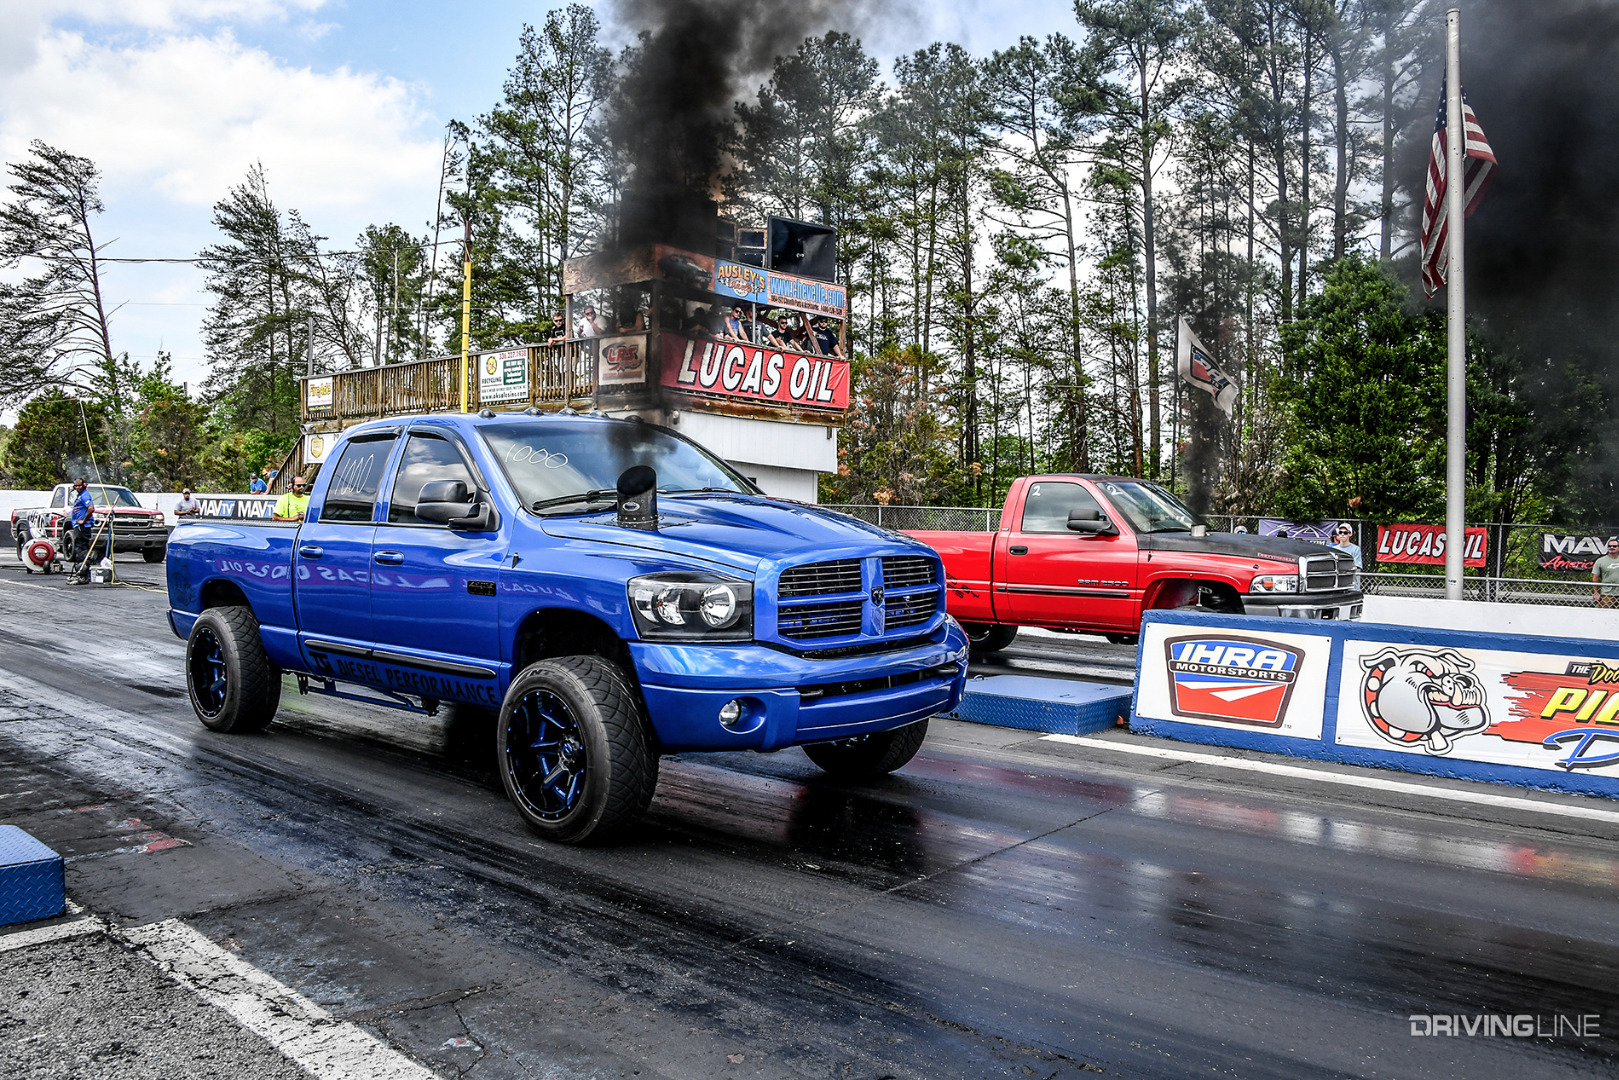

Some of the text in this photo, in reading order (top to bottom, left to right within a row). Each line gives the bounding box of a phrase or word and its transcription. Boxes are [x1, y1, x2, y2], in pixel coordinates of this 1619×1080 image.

[717, 264, 766, 289] AUSLEY'S
[770, 276, 844, 308] www.chevelle.com
[678, 339, 835, 403] LUCAS OIL
[505, 443, 569, 470] 1000
[1032, 484, 1041, 498] 2
[1105, 483, 1124, 498] 2
[198, 499, 277, 518] MAVTV MAVT
[1378, 529, 1485, 560] LUCAS IL
[1539, 554, 1595, 571] Americ
[1178, 642, 1288, 671] IHRA
[1570, 663, 1592, 675] THE
[337, 659, 384, 684] DIESEL
[386, 667, 499, 706] PERFORMANCE
[1175, 661, 1288, 682] MOTORSPORTS
